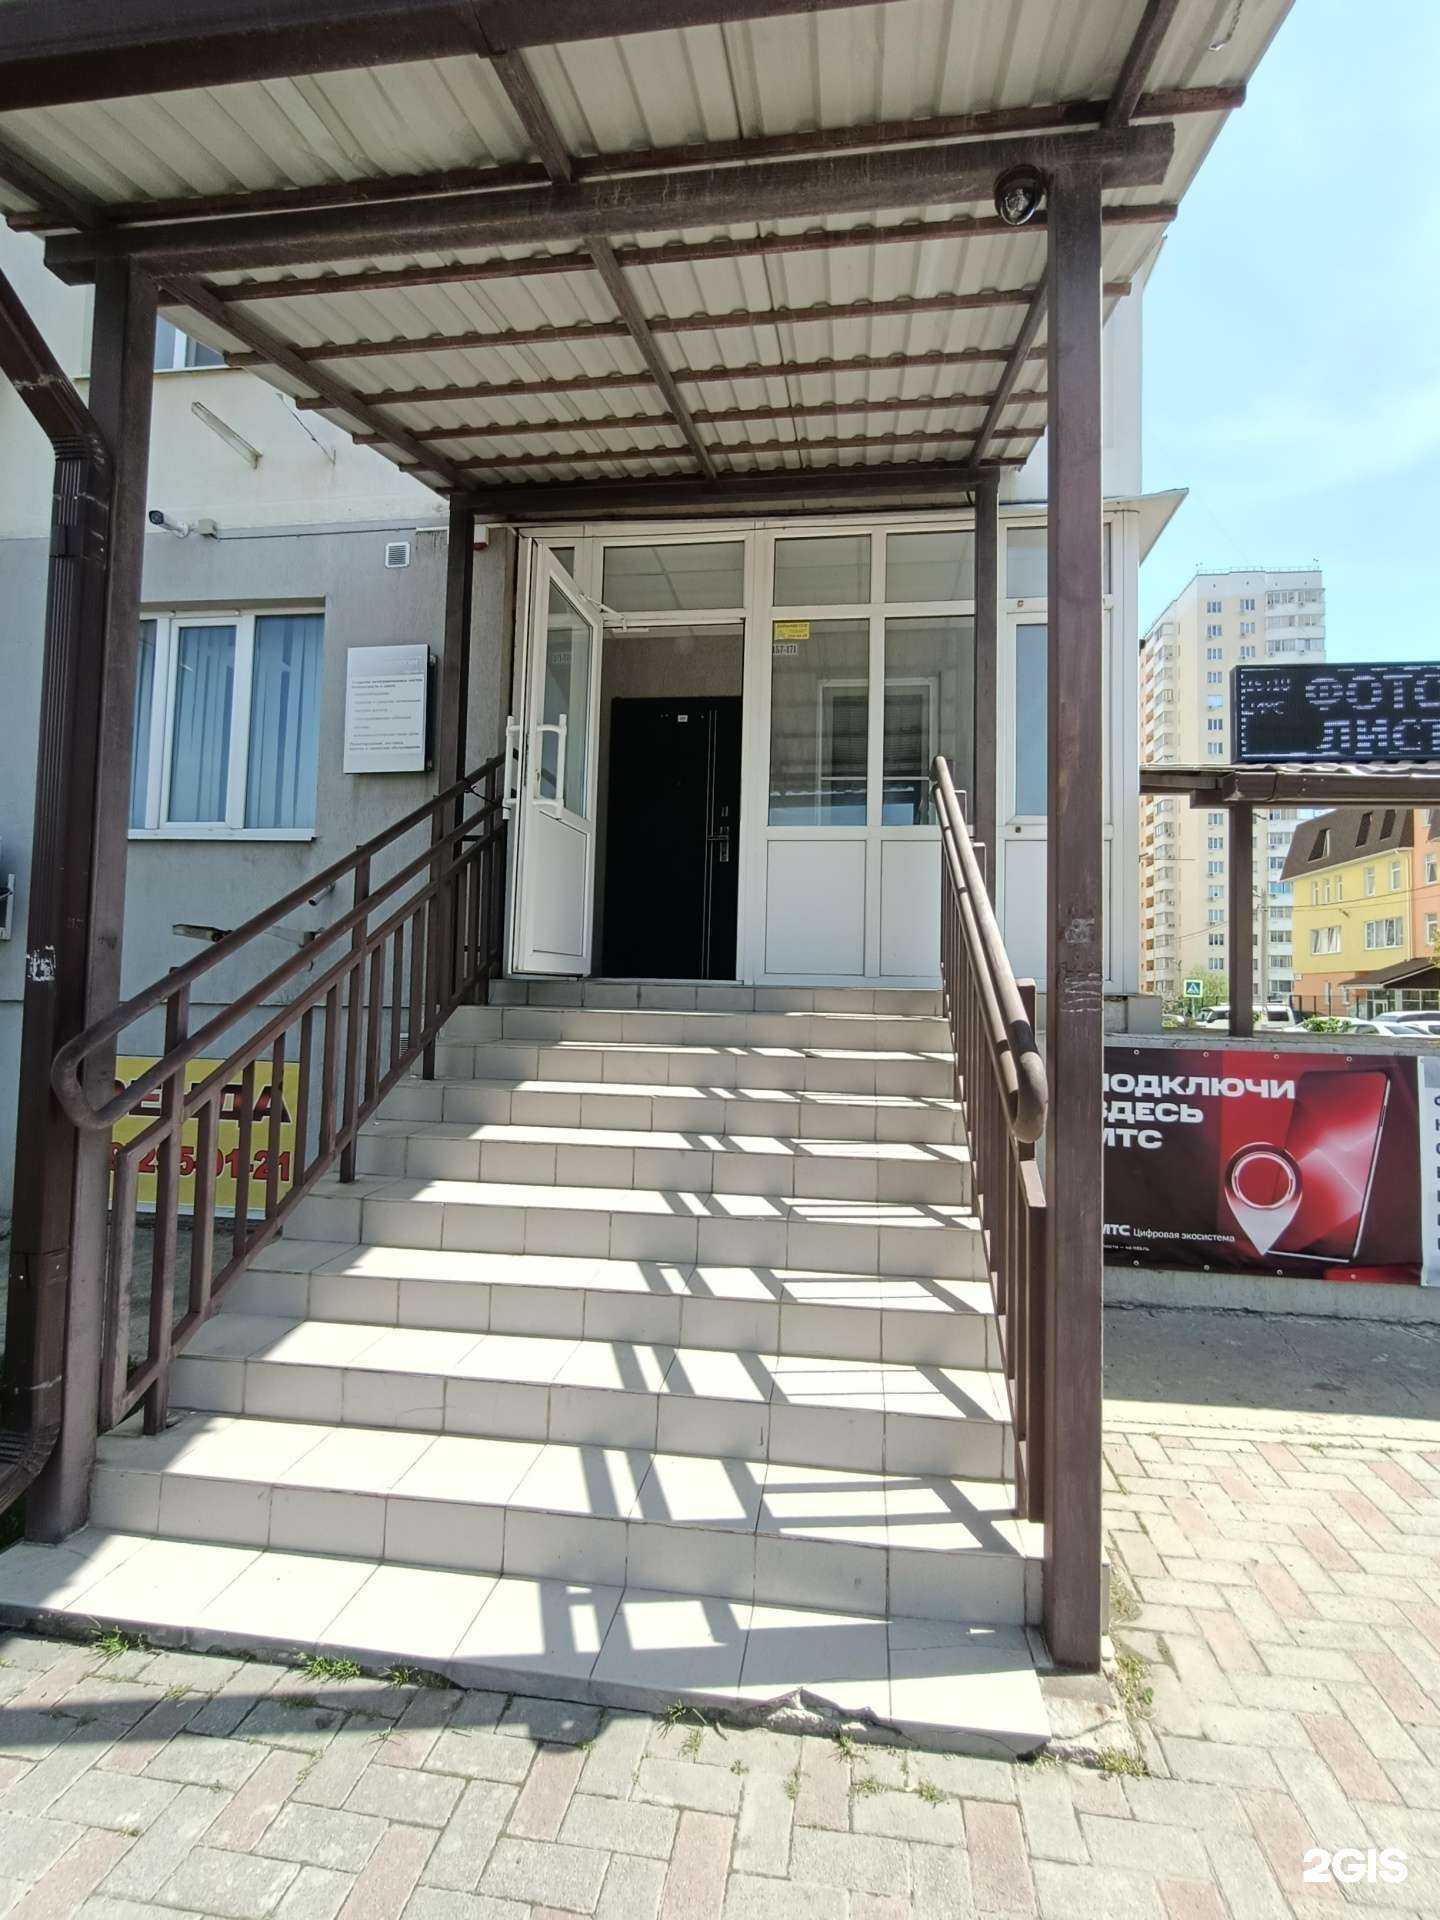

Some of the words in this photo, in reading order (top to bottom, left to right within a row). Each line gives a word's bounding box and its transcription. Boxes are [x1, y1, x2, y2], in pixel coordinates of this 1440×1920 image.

[1103, 1073, 1296, 1099] ОДКЛЮЧИ
[1103, 1101, 1204, 1124] ДЕСЬ
[1133, 1228, 1180, 1239] Цифровая
[1181, 1232, 1236, 1242] экосистема
